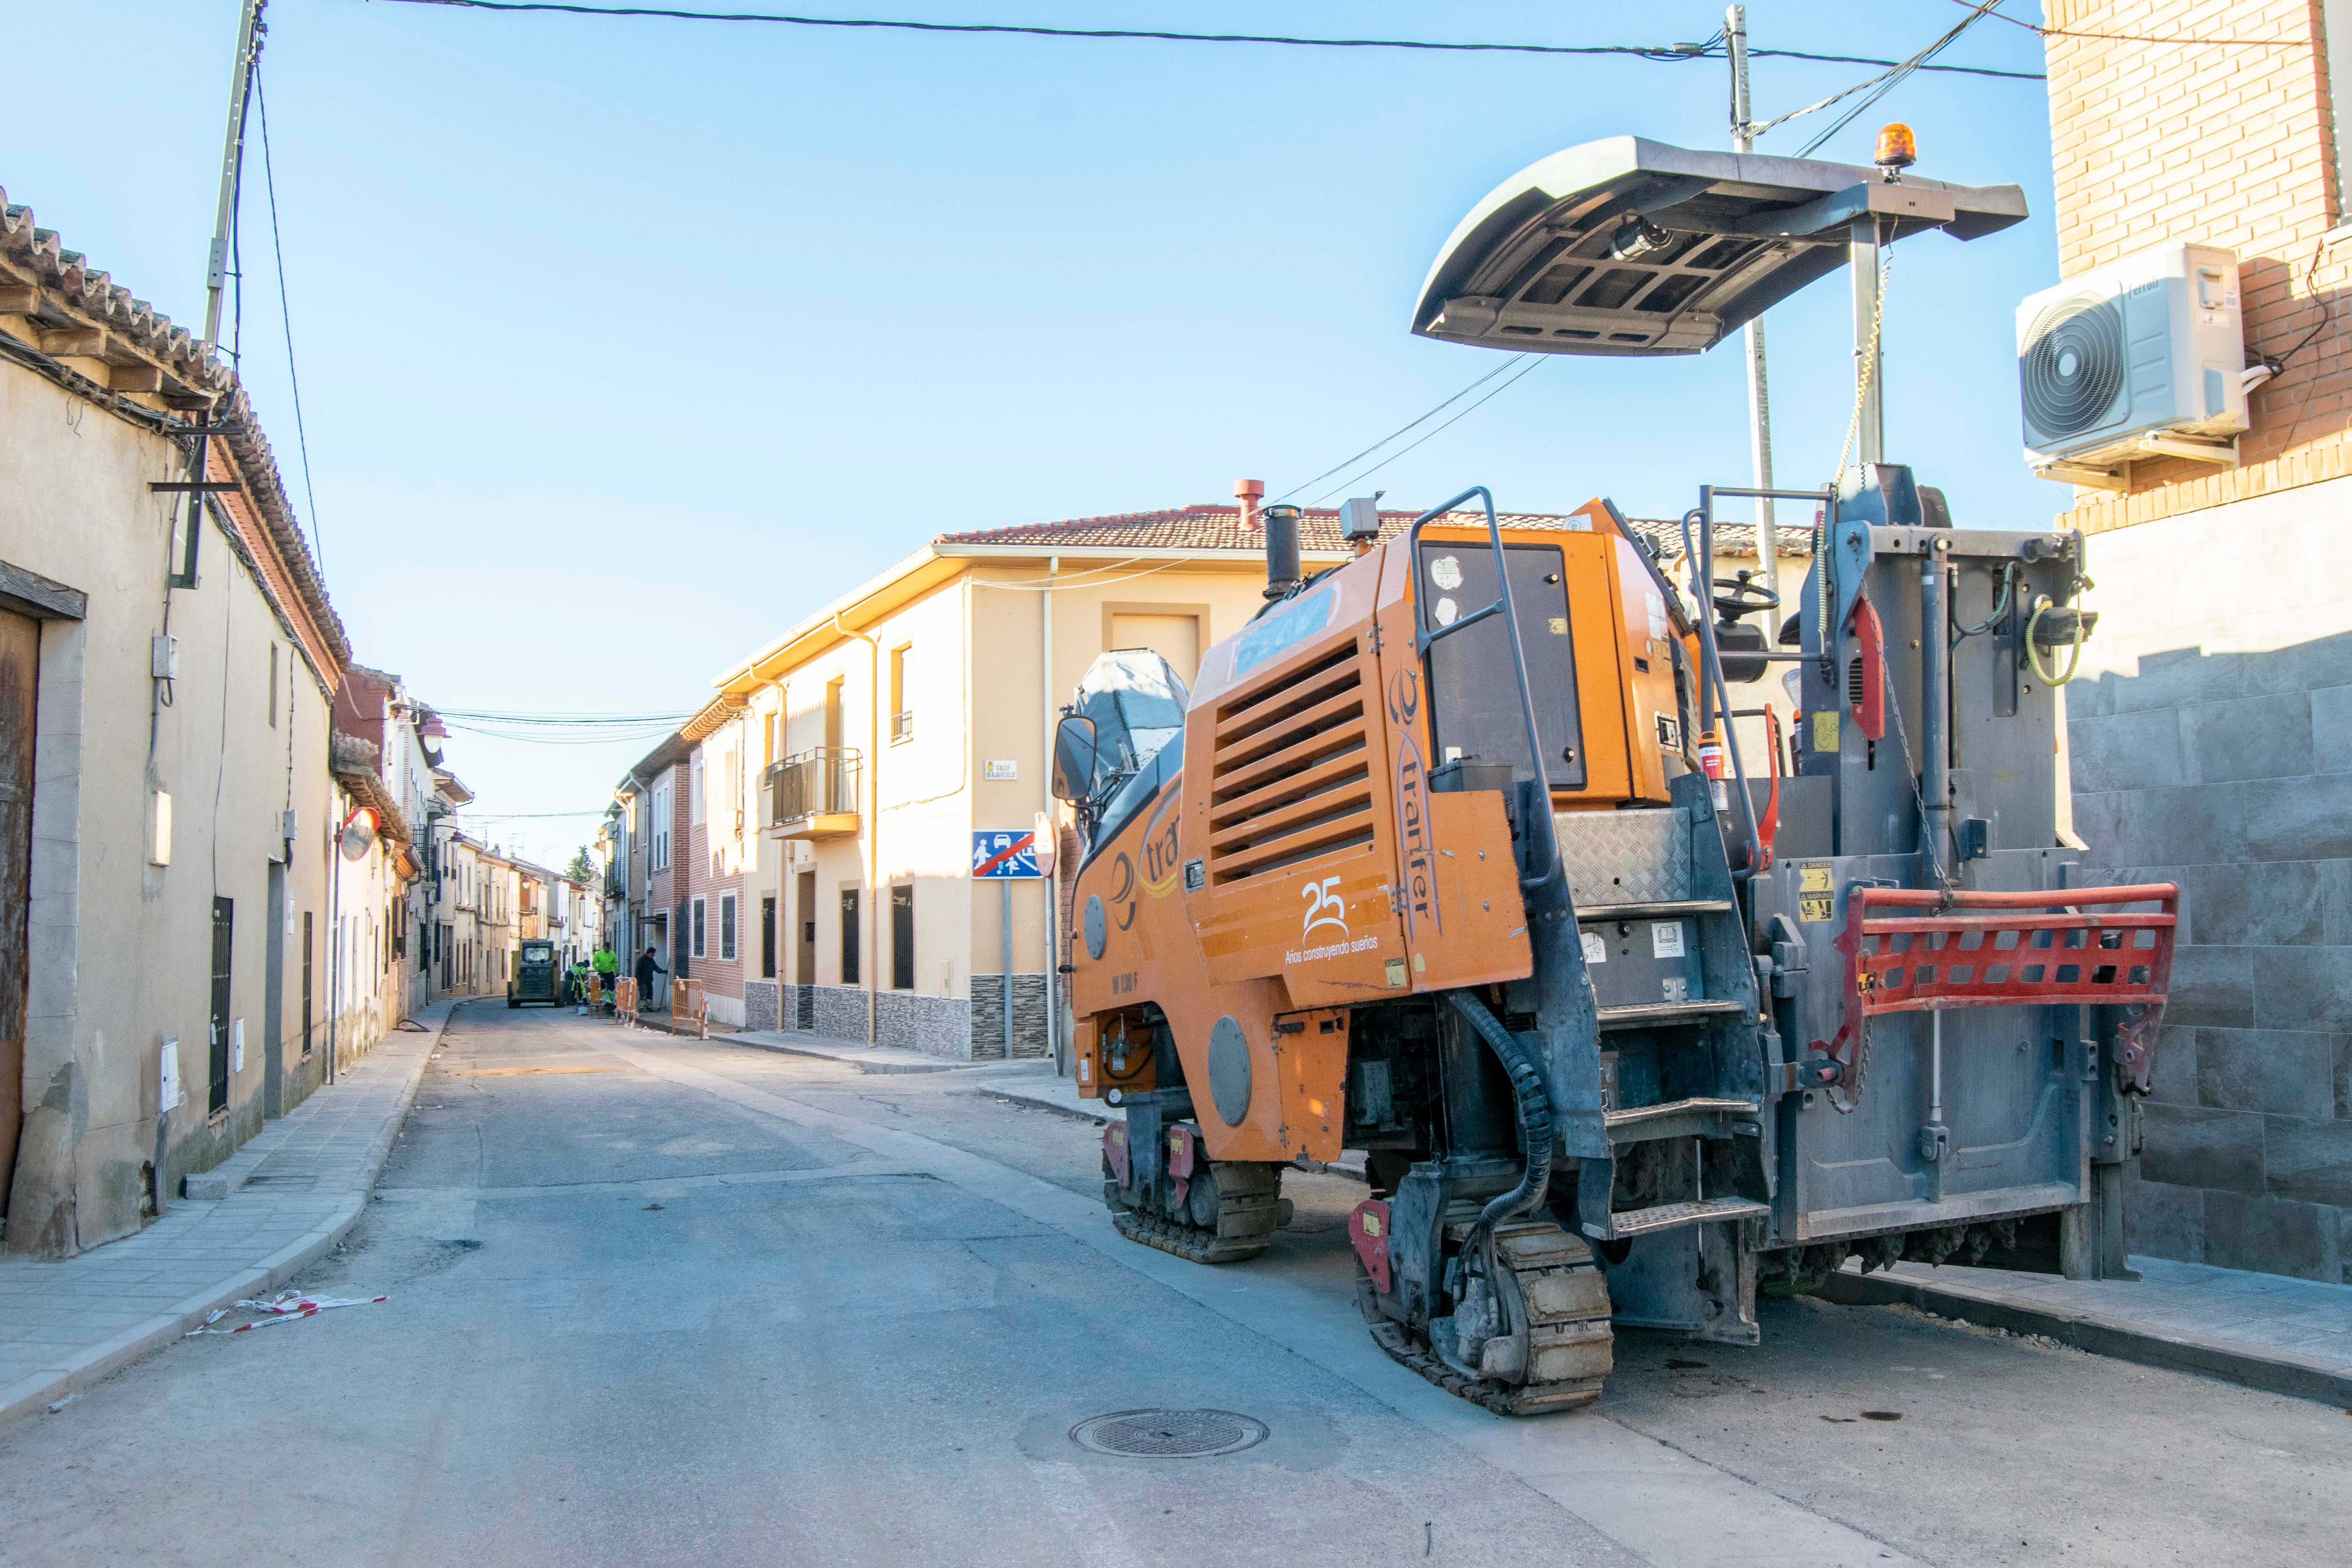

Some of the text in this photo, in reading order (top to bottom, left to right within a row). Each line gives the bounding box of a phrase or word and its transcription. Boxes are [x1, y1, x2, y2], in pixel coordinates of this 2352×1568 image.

[2128, 276, 2159, 300] Ferroli
[1302, 875, 1344, 930] 25
[1285, 934, 1378, 964] Años construyendo sueños
